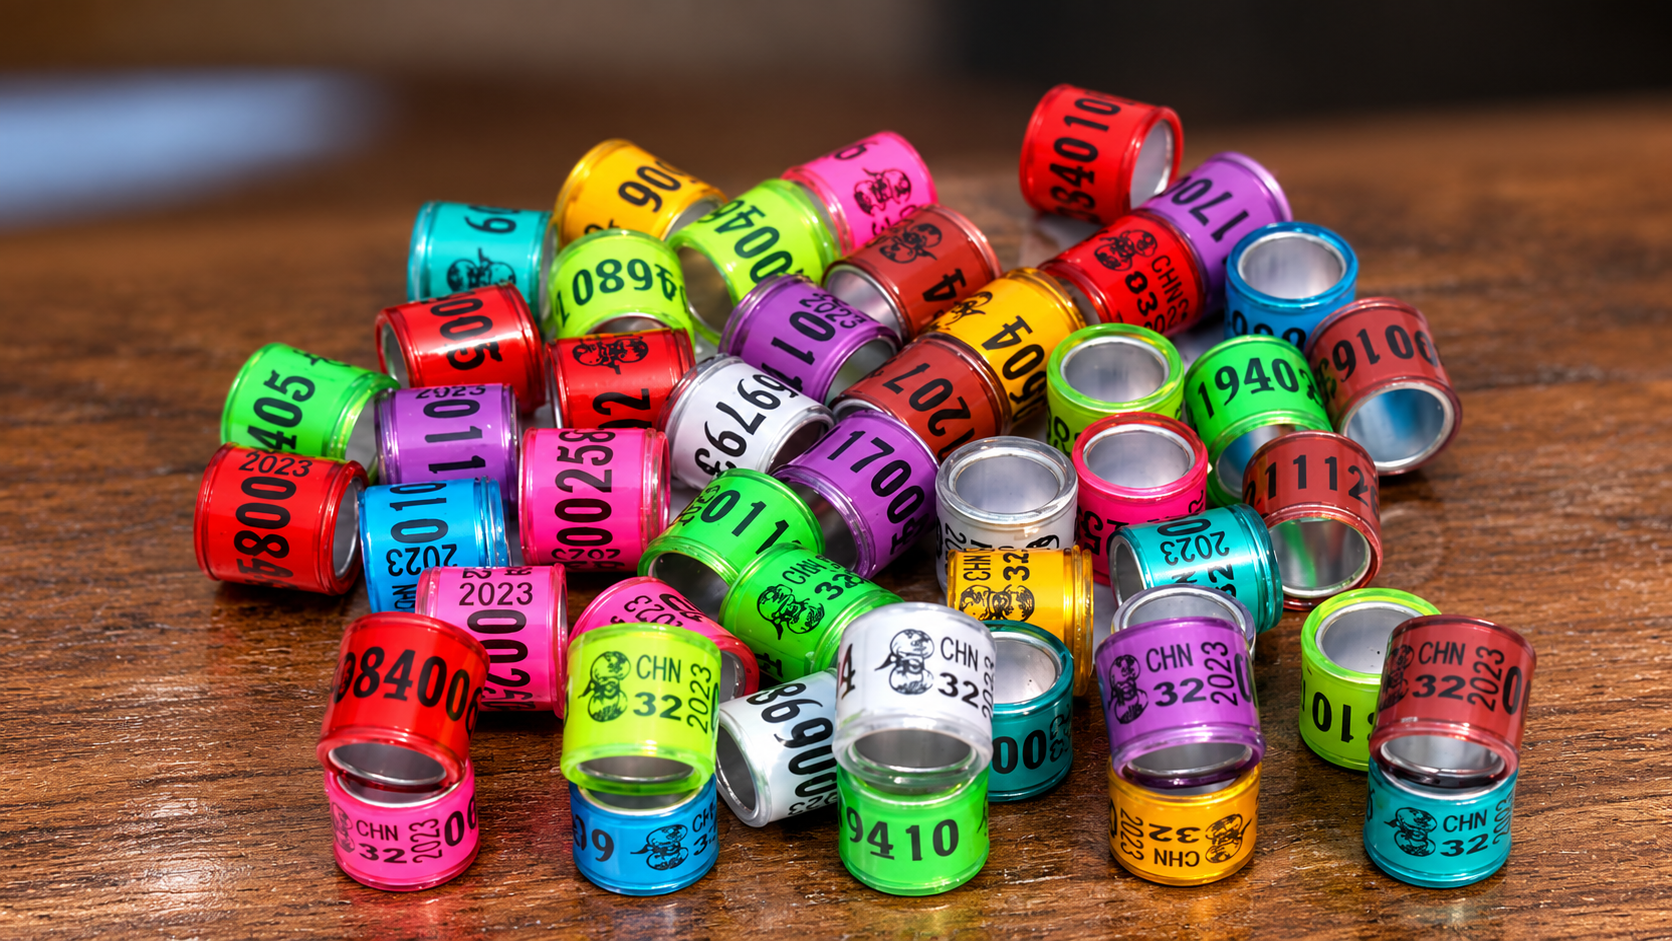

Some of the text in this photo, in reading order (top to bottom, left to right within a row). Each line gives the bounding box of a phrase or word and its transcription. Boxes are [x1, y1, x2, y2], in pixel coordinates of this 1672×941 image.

[1171, 178, 1249, 243] 170
[592, 388, 652, 428] 2
[239, 452, 313, 477] 2023
[1254, 454, 1377, 507] 1112
[234, 476, 296, 582] 0084
[1160, 531, 1229, 565] 2023
[459, 582, 533, 606] 2023
[636, 654, 682, 684] CHN
[940, 637, 978, 671] CHN
[1146, 642, 1193, 673] CHN
[1418, 641, 1466, 666] CHN
[1201, 641, 1238, 706] 2023
[1412, 674, 1465, 700] 32
[1467, 646, 1505, 712] 2023
[686, 663, 712, 734] 2023
[938, 672, 979, 708] 32
[1153, 678, 1206, 707] 32
[1502, 666, 1529, 717] 0
[633, 691, 682, 721] 32
[356, 820, 398, 841] CHN
[1121, 807, 1144, 861] 2023
[1149, 823, 1202, 844] 32
[1443, 810, 1488, 834] CHN
[360, 843, 407, 865] 32
[410, 819, 442, 864] 2023
[1440, 834, 1488, 857] 32
[1154, 848, 1200, 867] CHN
